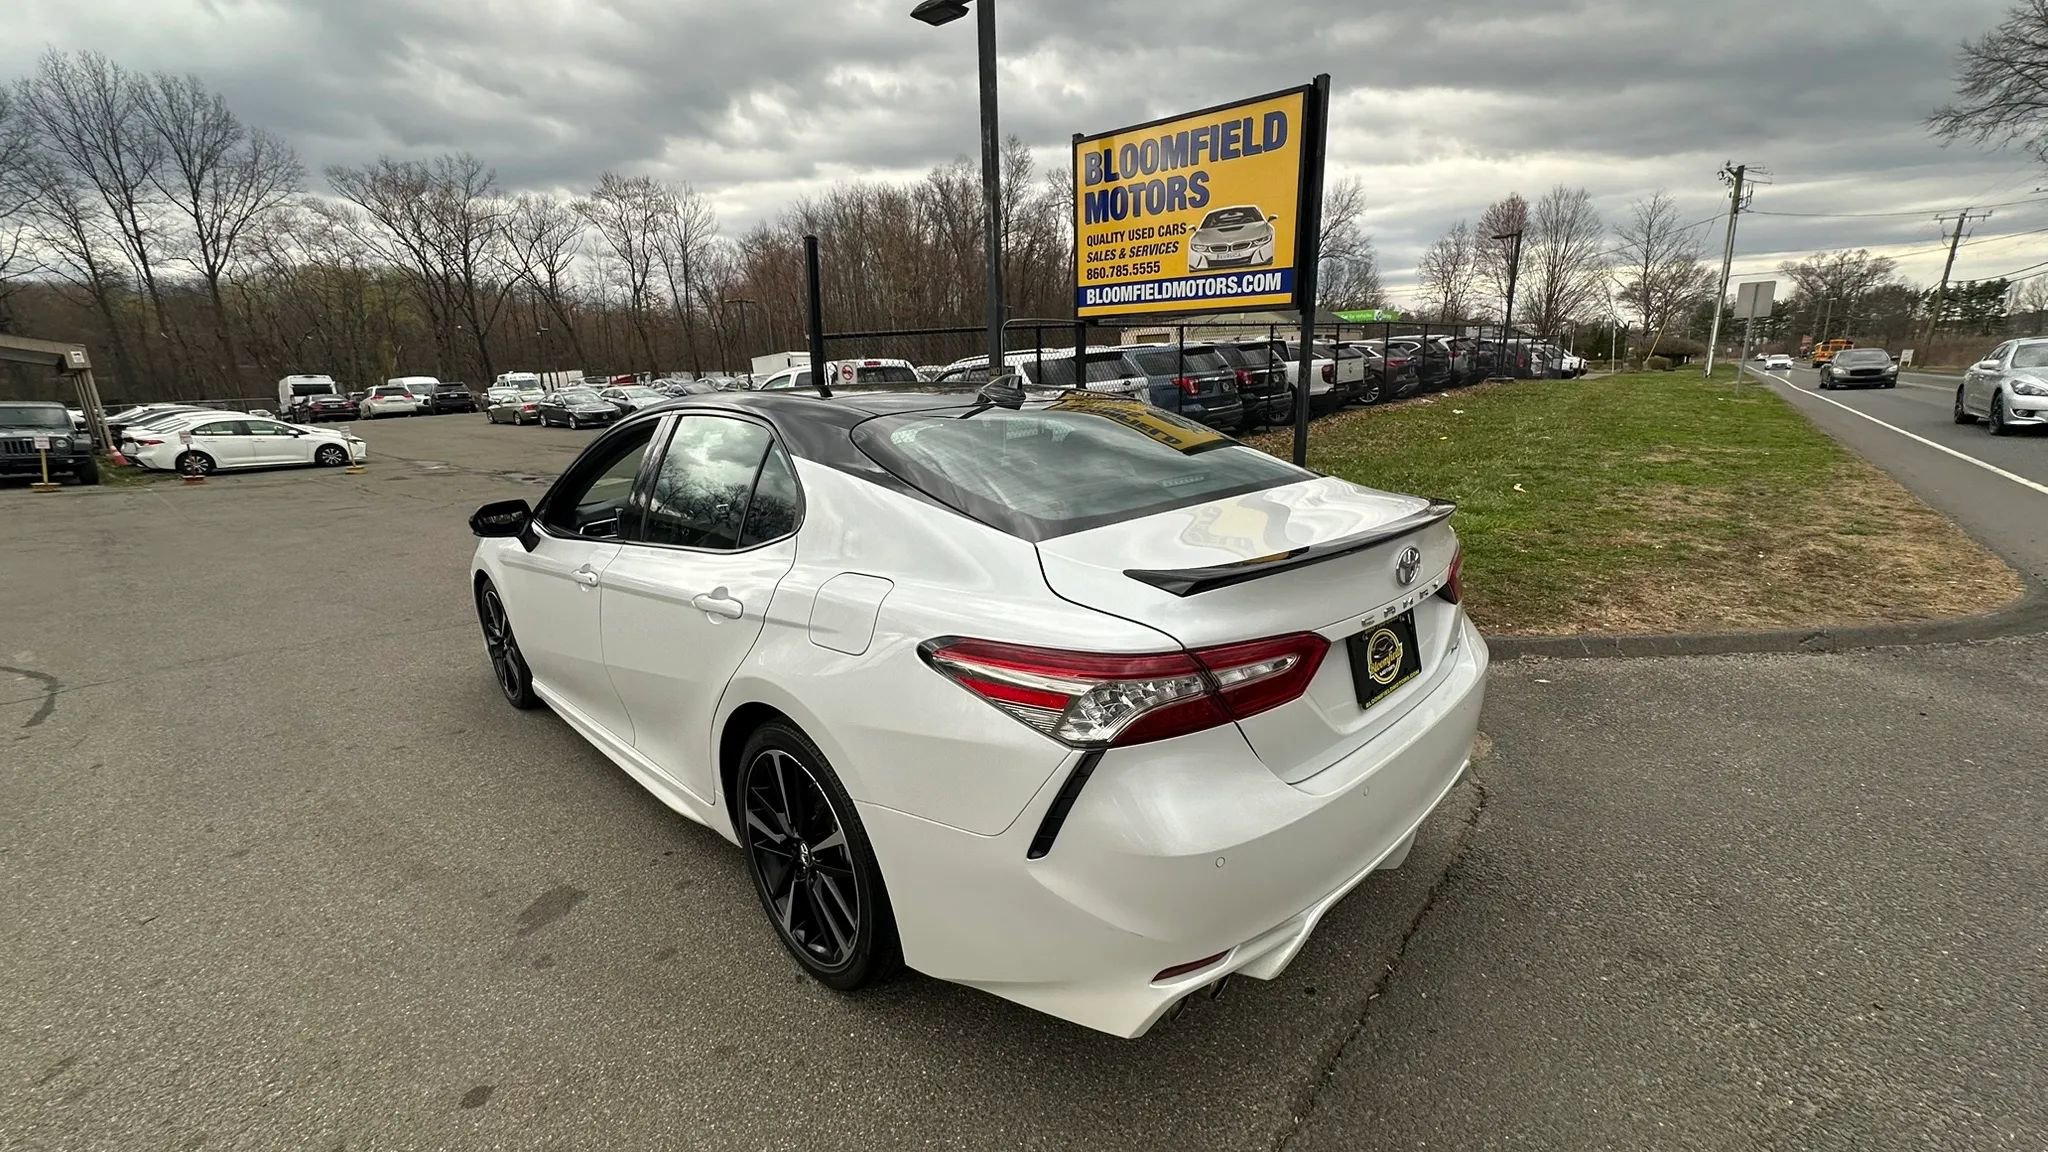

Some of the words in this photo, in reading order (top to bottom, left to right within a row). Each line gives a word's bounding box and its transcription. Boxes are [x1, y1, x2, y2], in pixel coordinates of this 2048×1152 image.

[1084, 110, 1288, 187] BLOOMFIELD
[1084, 171, 1210, 225] MOTORS
[1086, 229, 1125, 247] QUALITY
[1128, 226, 1155, 241] USED
[1158, 222, 1187, 238] CARS
[1086, 248, 1116, 264] SALES
[1118, 247, 1127, 259] &
[1128, 241, 1179, 258] SERVICES
[1086, 261, 1160, 280] 860.785.5555
[1086, 272, 1282, 305] BLOOMFIELDMOTORS.COM
